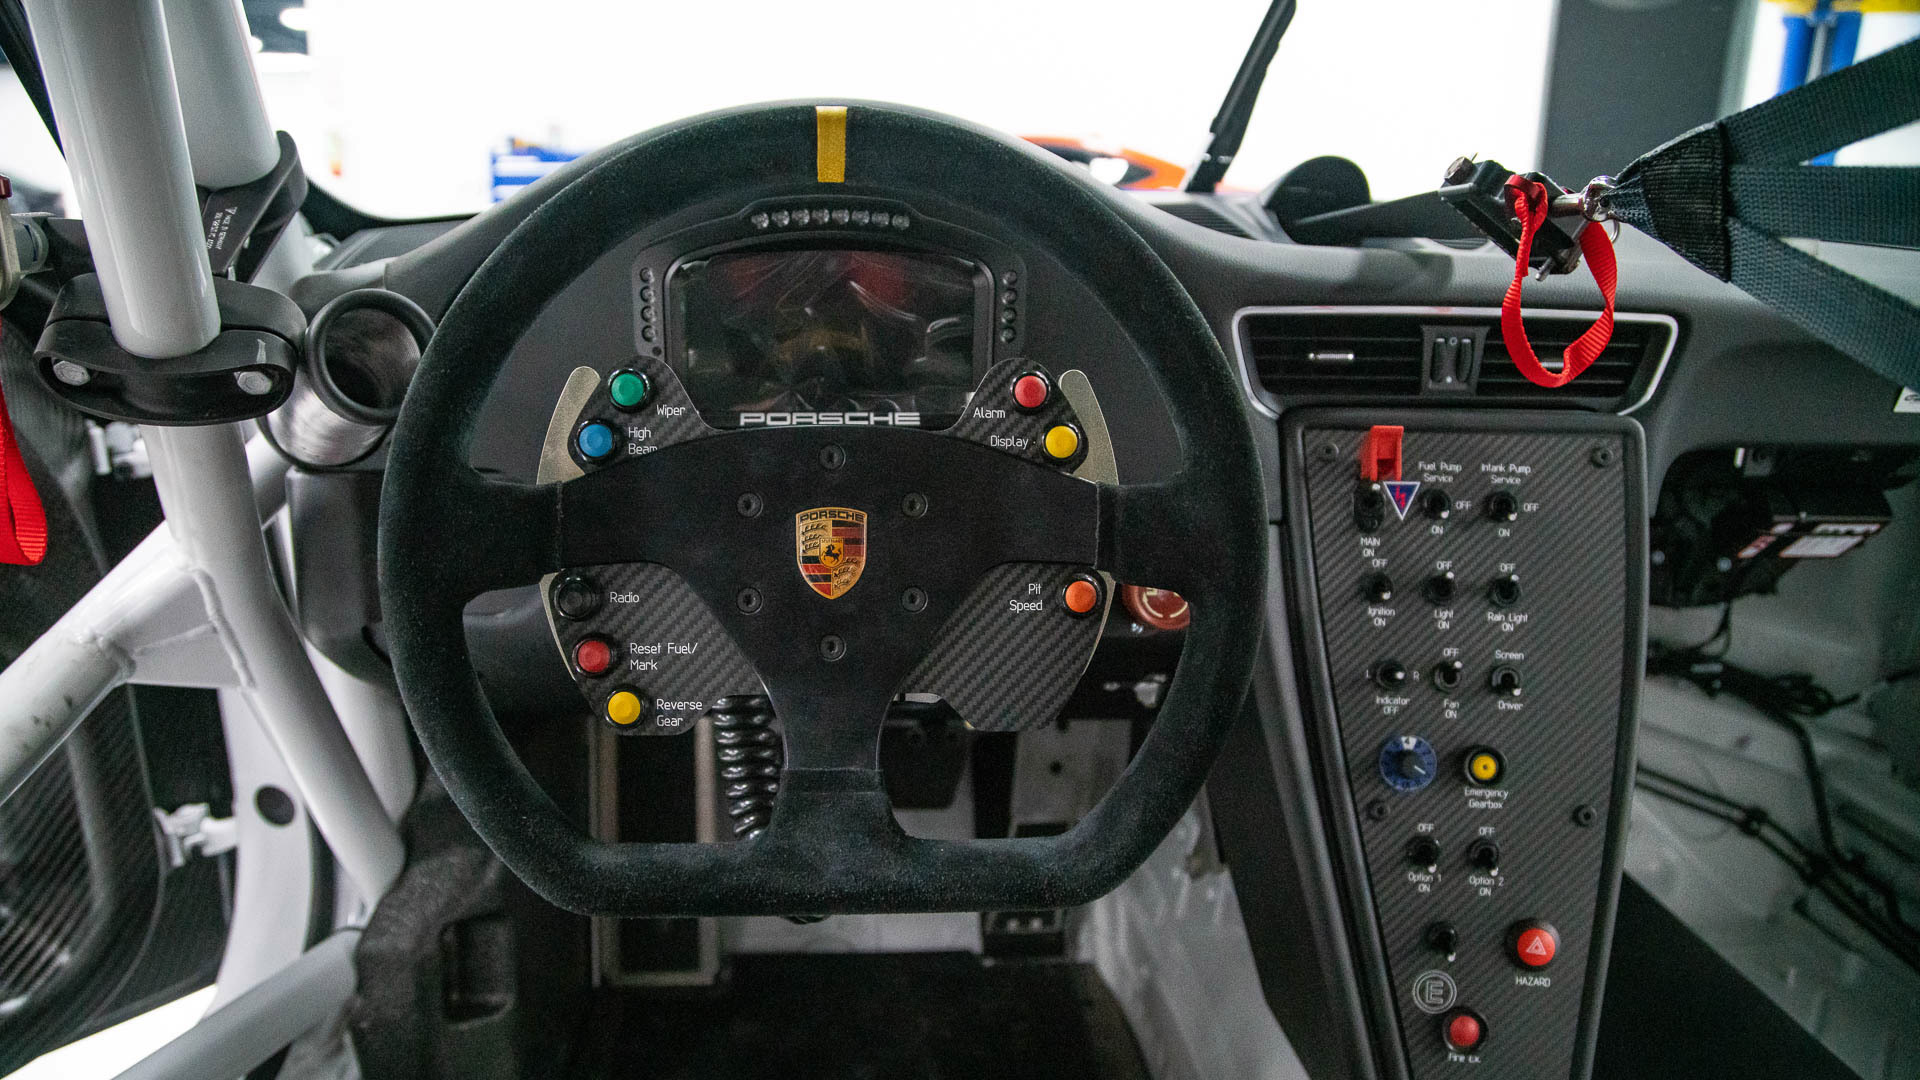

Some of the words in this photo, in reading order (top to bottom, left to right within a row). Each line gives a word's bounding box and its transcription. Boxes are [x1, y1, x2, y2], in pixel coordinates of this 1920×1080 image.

[656, 404, 686, 419] Wiper
[973, 406, 1006, 419] Alarm
[739, 412, 921, 426] PORSCHE
[628, 426, 651, 441] High
[990, 434, 1029, 450] Display
[1418, 461, 1437, 471] Fuel
[1440, 461, 1462, 473] Pump
[1509, 463, 1531, 474] Pump
[1423, 472, 1454, 483] Service
[1491, 474, 1522, 485] Service
[1455, 500, 1472, 510] OFF
[1523, 502, 1540, 513] OFF
[800, 509, 865, 522] PORSCHE
[1431, 525, 1444, 535] ON
[1498, 528, 1511, 537] ON
[1360, 537, 1381, 547] MAIN
[1362, 547, 1375, 557] ON
[1371, 558, 1388, 568] OFF
[1436, 561, 1453, 570] OFF
[1499, 563, 1516, 573] OFF
[1028, 583, 1042, 595] Pit
[609, 591, 640, 603] Radio
[1009, 599, 1043, 614] Speed
[1367, 606, 1396, 617] Ignition
[1434, 609, 1454, 620] Light
[1487, 612, 1506, 622] Rain
[1508, 613, 1528, 625] Light
[1373, 618, 1386, 627] ON
[1437, 620, 1450, 630] ON
[1501, 622, 1514, 632] ON
[629, 642, 662, 655] Reset
[667, 642, 698, 655] Fuel/
[1443, 648, 1460, 657] OFF
[1495, 650, 1525, 661] Screen
[629, 659, 658, 671] Mark
[1365, 669, 1371, 679] L
[1413, 671, 1420, 680] R
[656, 699, 703, 711] Reverse
[1375, 695, 1410, 705] Indicator
[1443, 700, 1460, 709] Fan
[1498, 700, 1524, 711] Driver
[1383, 706, 1399, 715] OFF
[1445, 709, 1457, 719] ON
[656, 714, 684, 727] Gear
[1464, 787, 1509, 799] Emergency
[1468, 799, 1504, 809] Gearbox
[1417, 823, 1434, 832] OFF
[1479, 826, 1496, 836] OFF
[1408, 871, 1434, 884] Option
[1437, 873, 1442, 883] 1
[1469, 875, 1495, 887] Option
[1498, 876, 1505, 887] 2
[1418, 884, 1431, 893] ON
[1479, 887, 1492, 897] ON
[1515, 975, 1551, 988] HAZARD
[1425, 980, 1444, 1004] E
